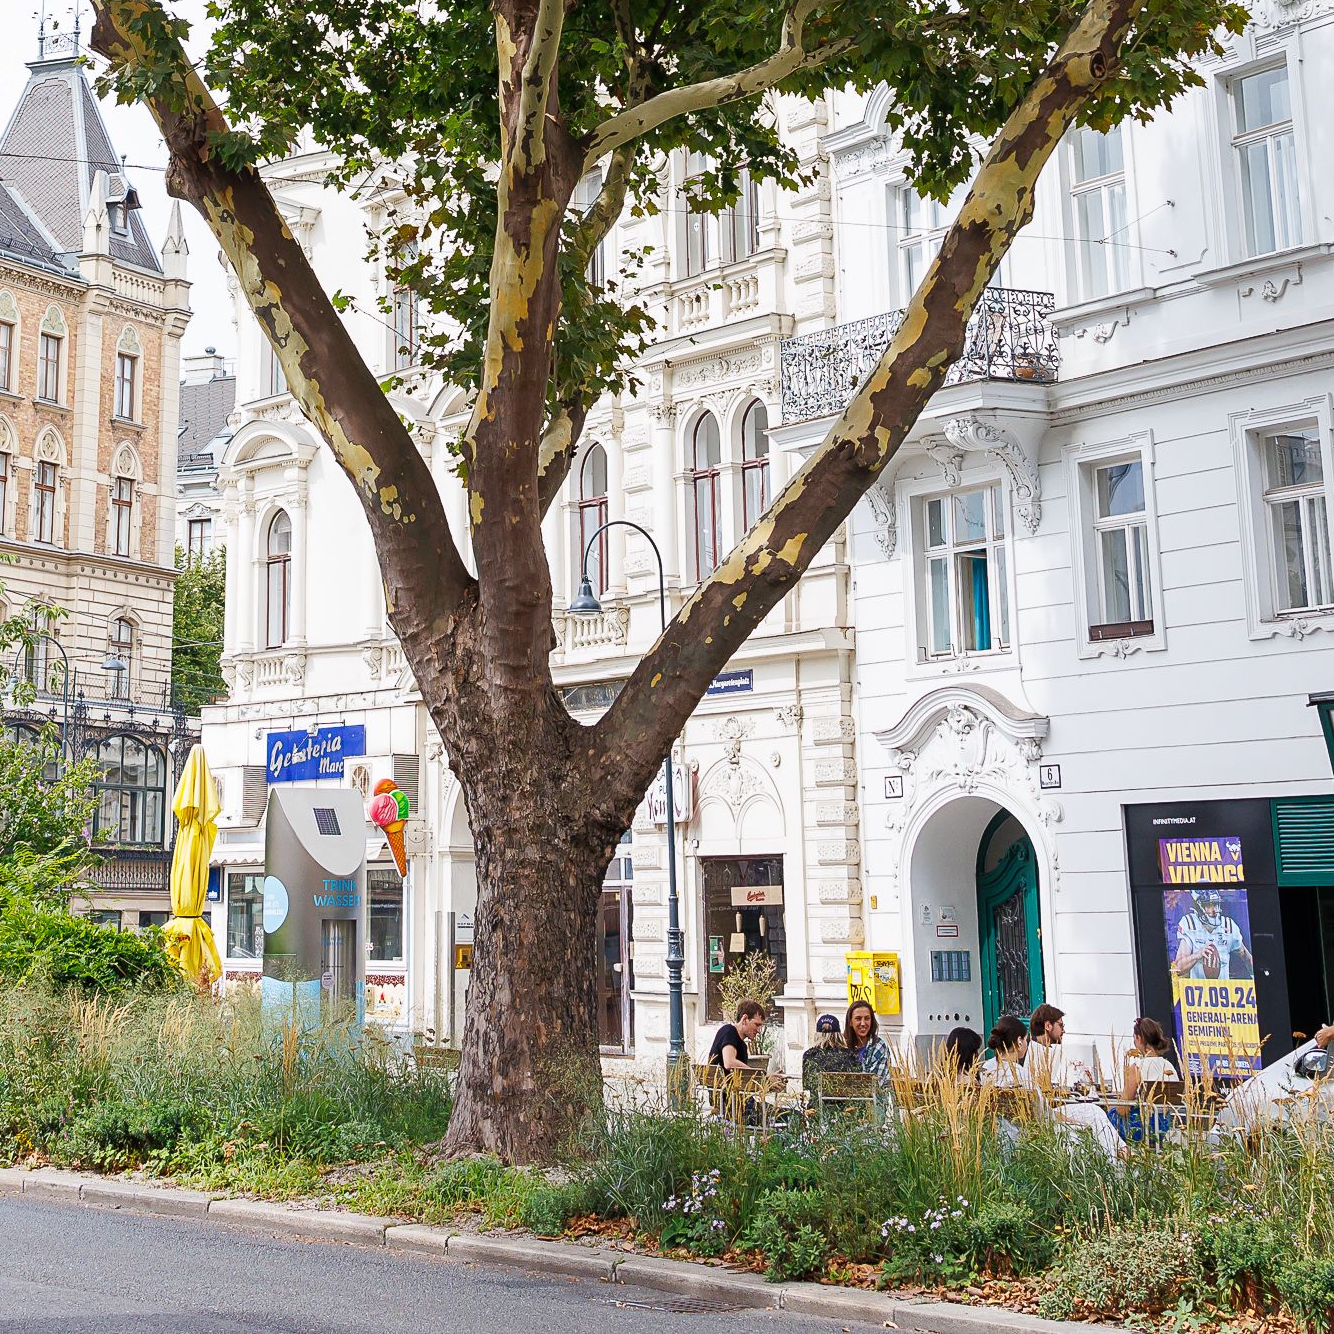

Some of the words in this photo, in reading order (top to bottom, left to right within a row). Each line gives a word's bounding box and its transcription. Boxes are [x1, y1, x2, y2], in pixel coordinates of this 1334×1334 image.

[1047, 767, 1053, 780] 6
[1152, 816, 1196, 825] INFINITYMEDIA.AT
[1166, 841, 1222, 863] VIENNA
[1185, 985, 1256, 1008] 07.09.24
[1187, 1011, 1258, 1025] GENERALI-ARENA
